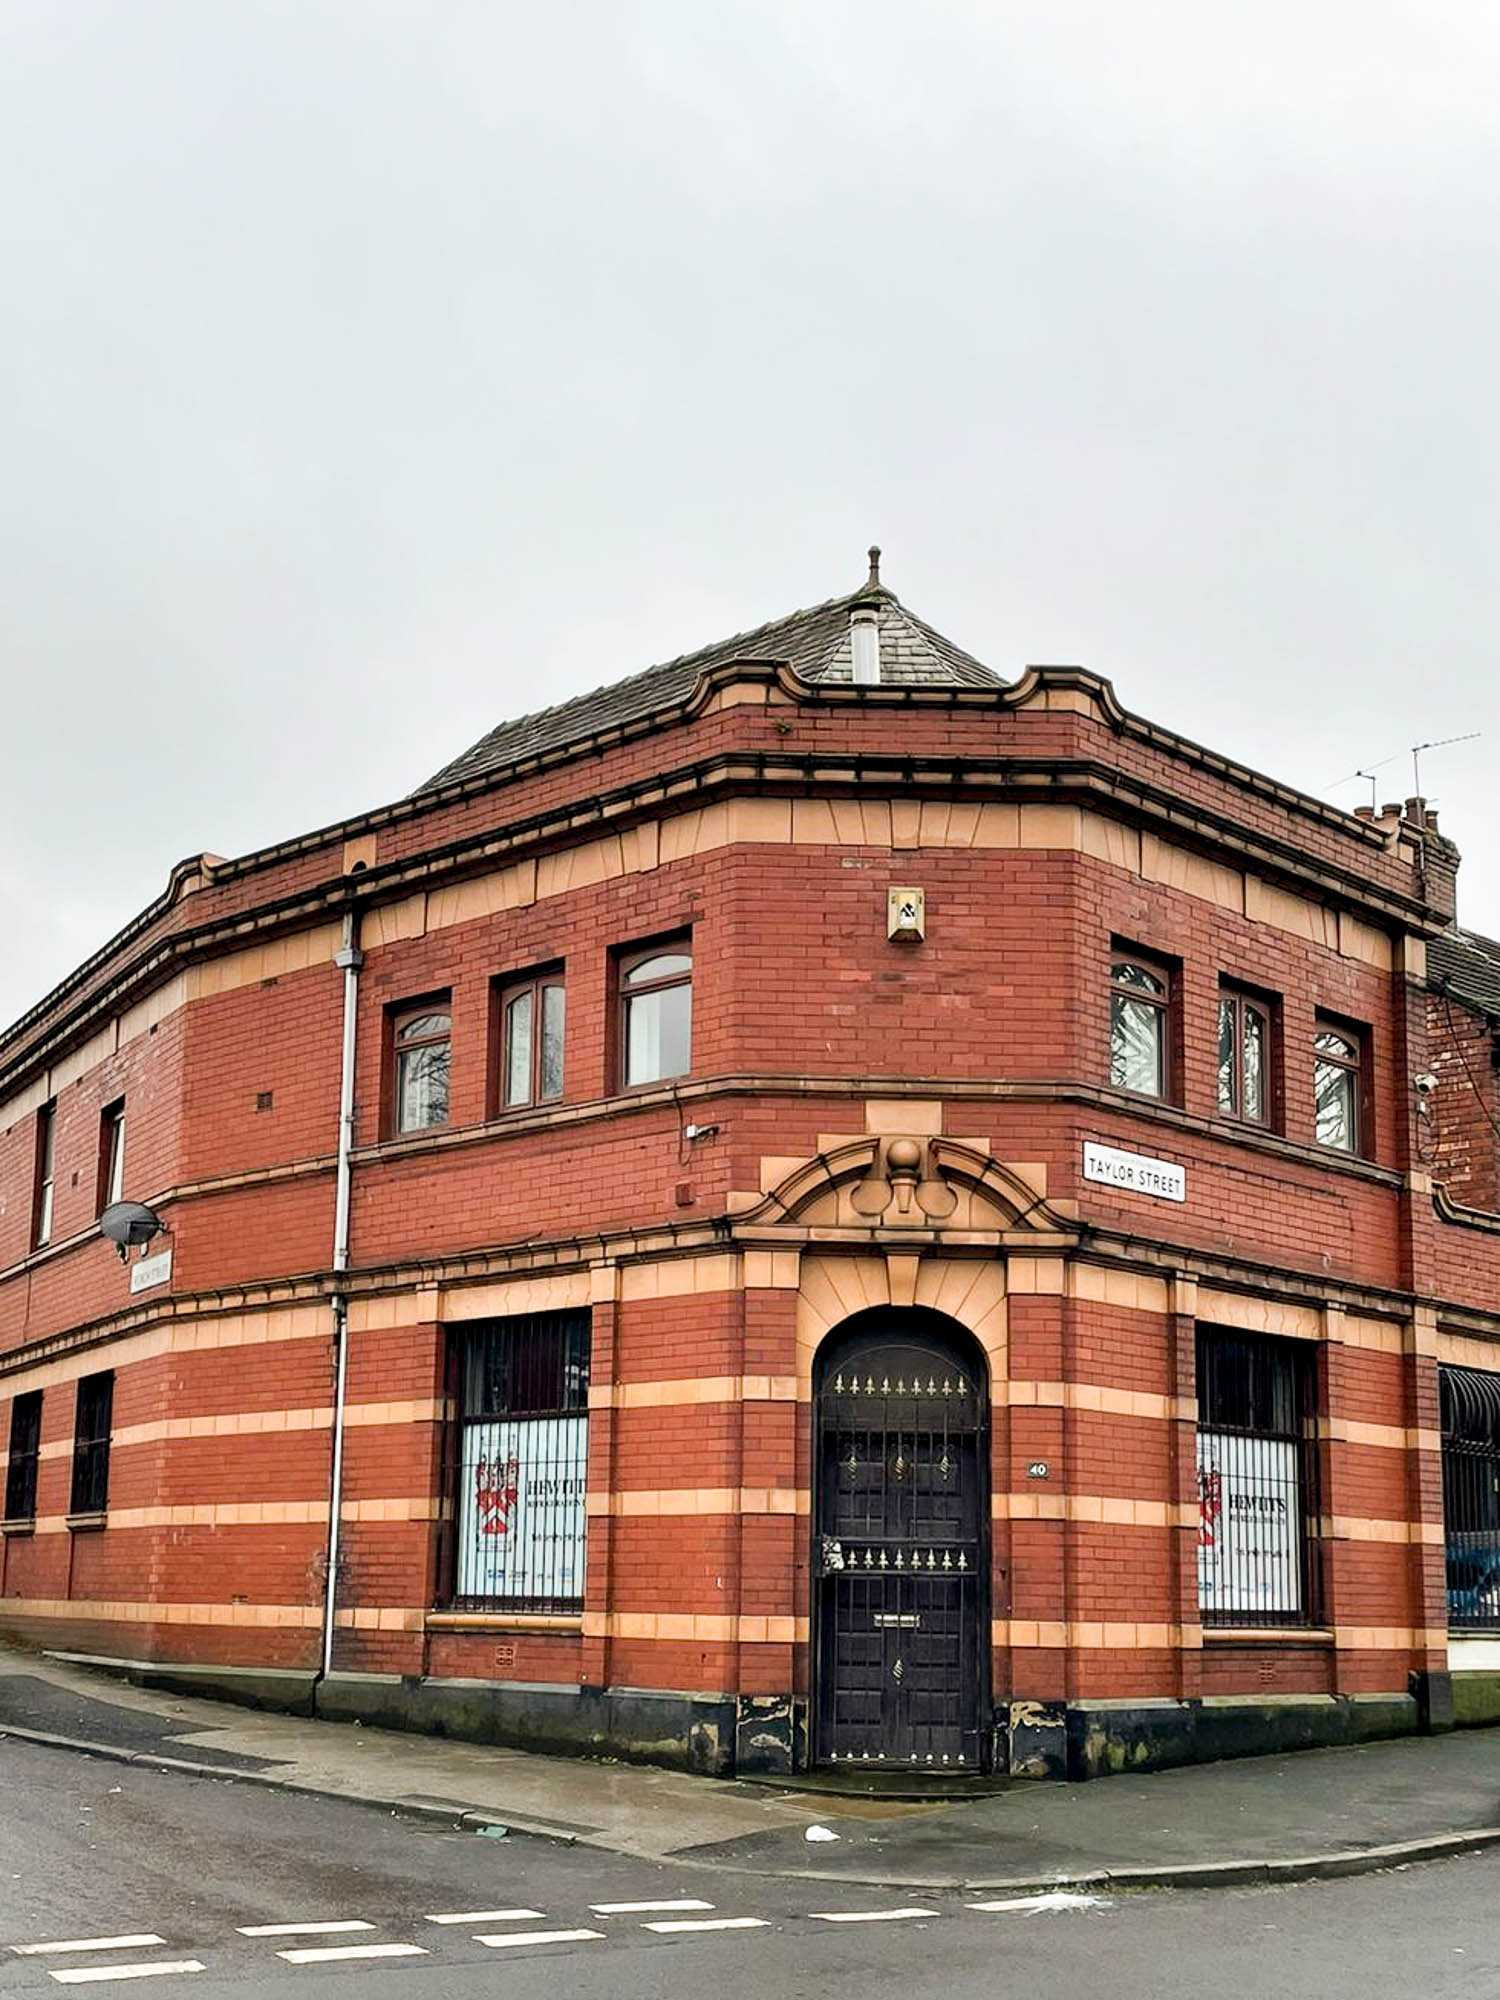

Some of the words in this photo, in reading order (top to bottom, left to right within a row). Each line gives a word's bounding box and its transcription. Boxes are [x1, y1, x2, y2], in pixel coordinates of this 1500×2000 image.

[1088, 1157, 1134, 1184] TAYLOR
[1139, 1170, 1181, 1194] STREET
[1029, 1464, 1046, 1476] 40
